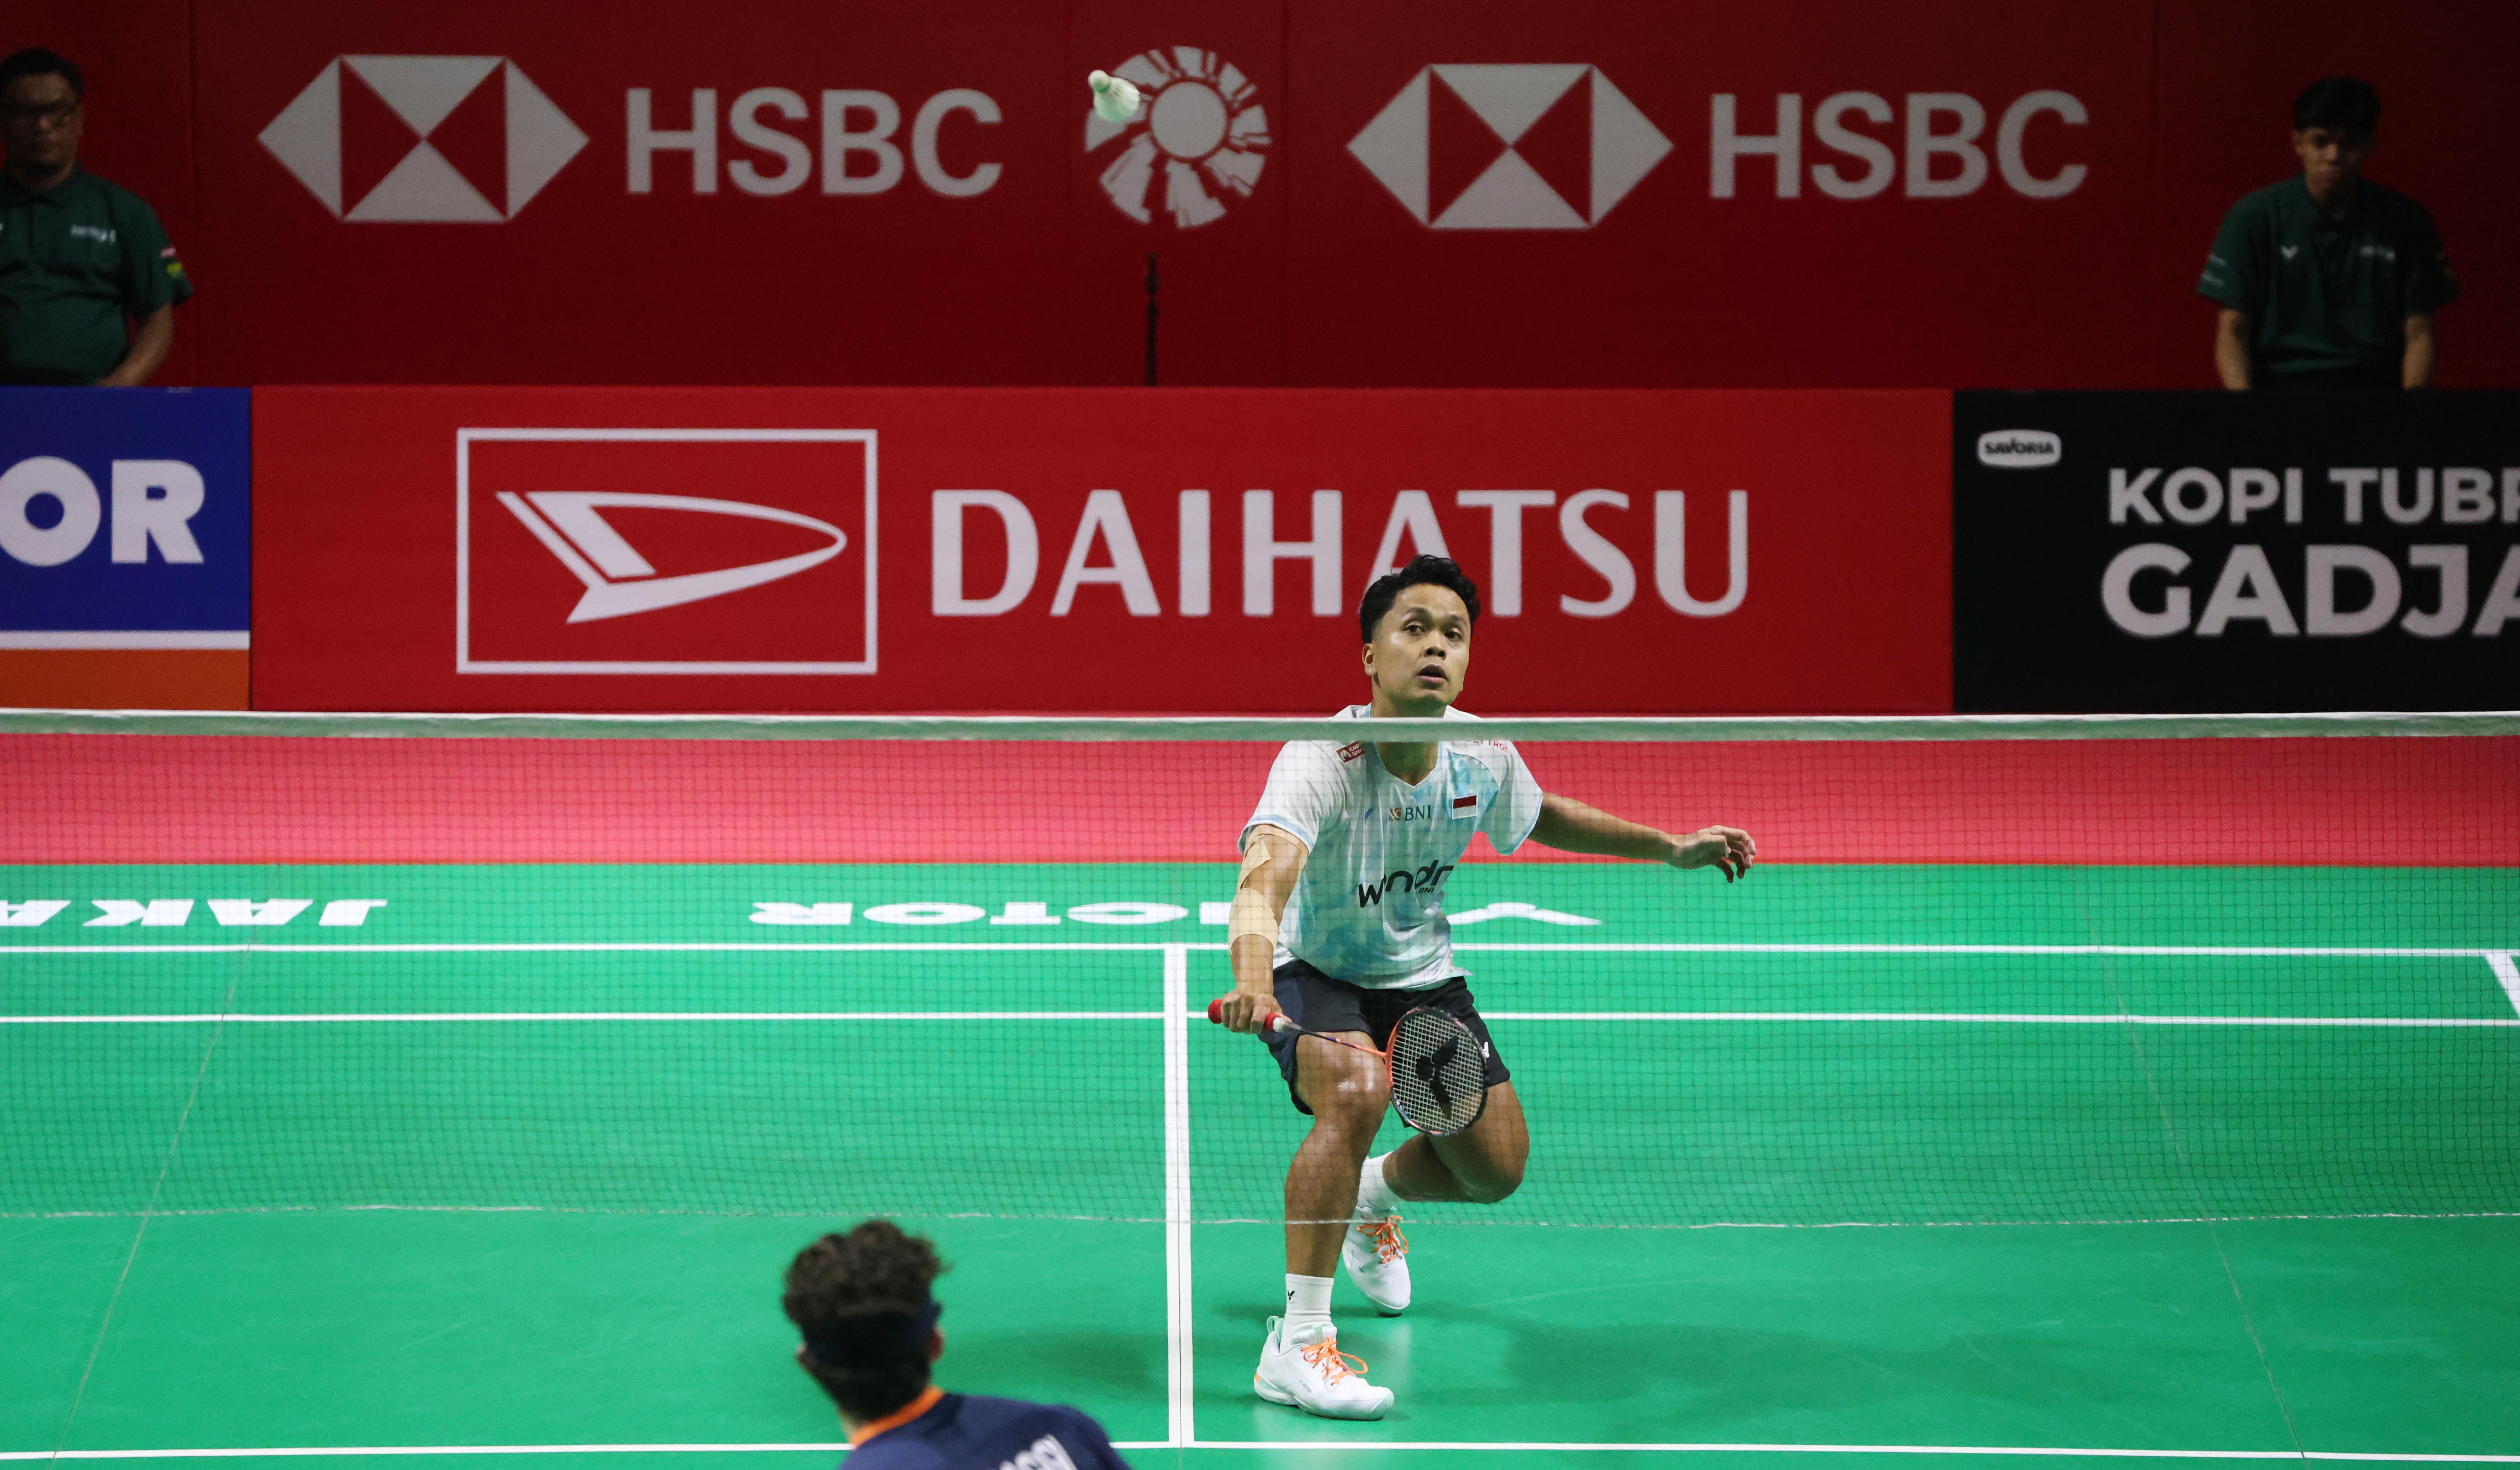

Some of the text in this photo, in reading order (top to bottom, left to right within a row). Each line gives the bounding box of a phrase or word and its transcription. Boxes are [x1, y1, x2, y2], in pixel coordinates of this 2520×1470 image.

[626, 86, 1003, 198] HSBC
[1710, 89, 2089, 200] HSBC
[1985, 438, 2055, 454] SAVORIA
[0, 456, 205, 567] OR
[2108, 467, 2303, 525] KOPI
[932, 488, 1748, 617] DAIHATSU
[1349, 743, 1360, 752] Kap
[1404, 804, 1432, 821] BNI
[1358, 859, 1454, 908] wndr
[748, 901, 1232, 926] ICTOR
